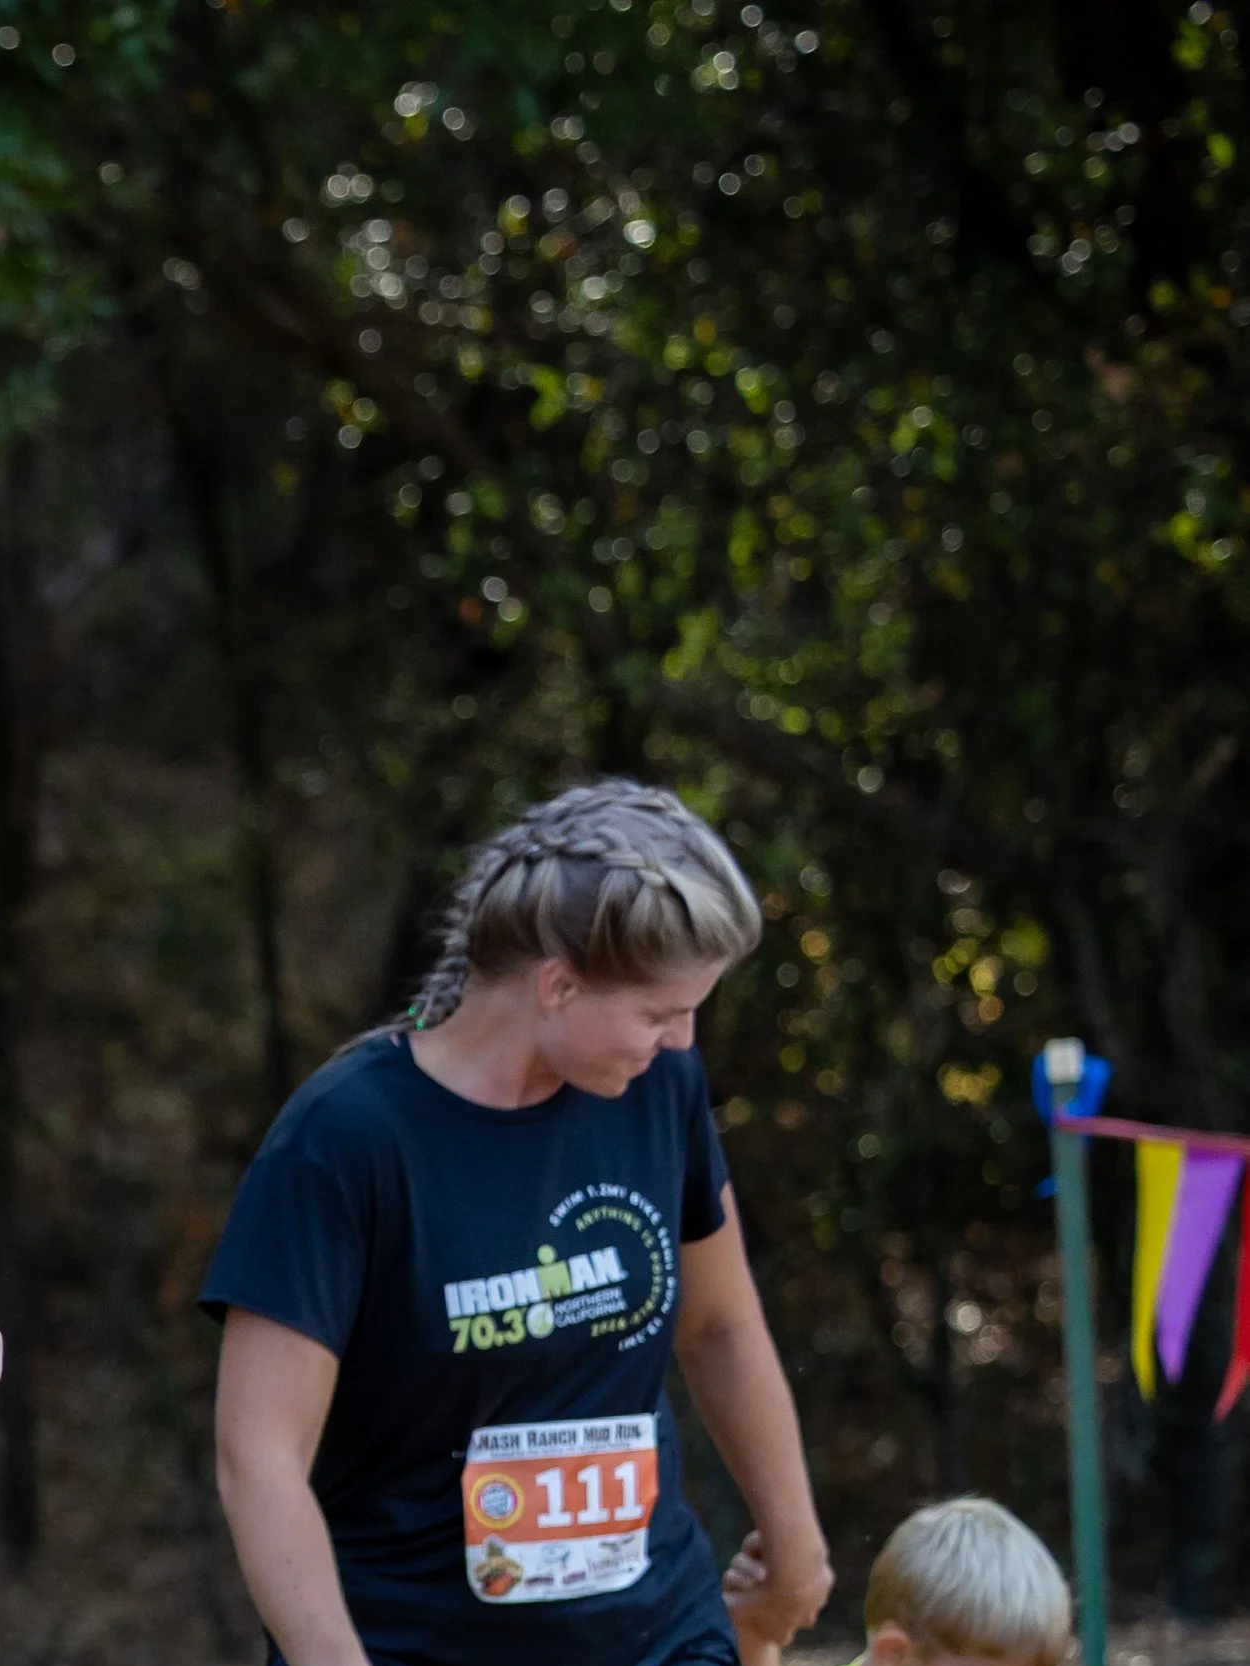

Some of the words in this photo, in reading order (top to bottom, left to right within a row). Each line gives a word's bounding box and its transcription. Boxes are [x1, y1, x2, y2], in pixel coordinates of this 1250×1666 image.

[444, 1245, 624, 1319] IRONMAN
[450, 1309, 527, 1354] 70.3
[478, 1432, 520, 1450] NASH
[527, 1428, 577, 1447] RANCH
[583, 1425, 610, 1443] MUD
[614, 1423, 642, 1440] RUN
[534, 1460, 646, 1529] 111
